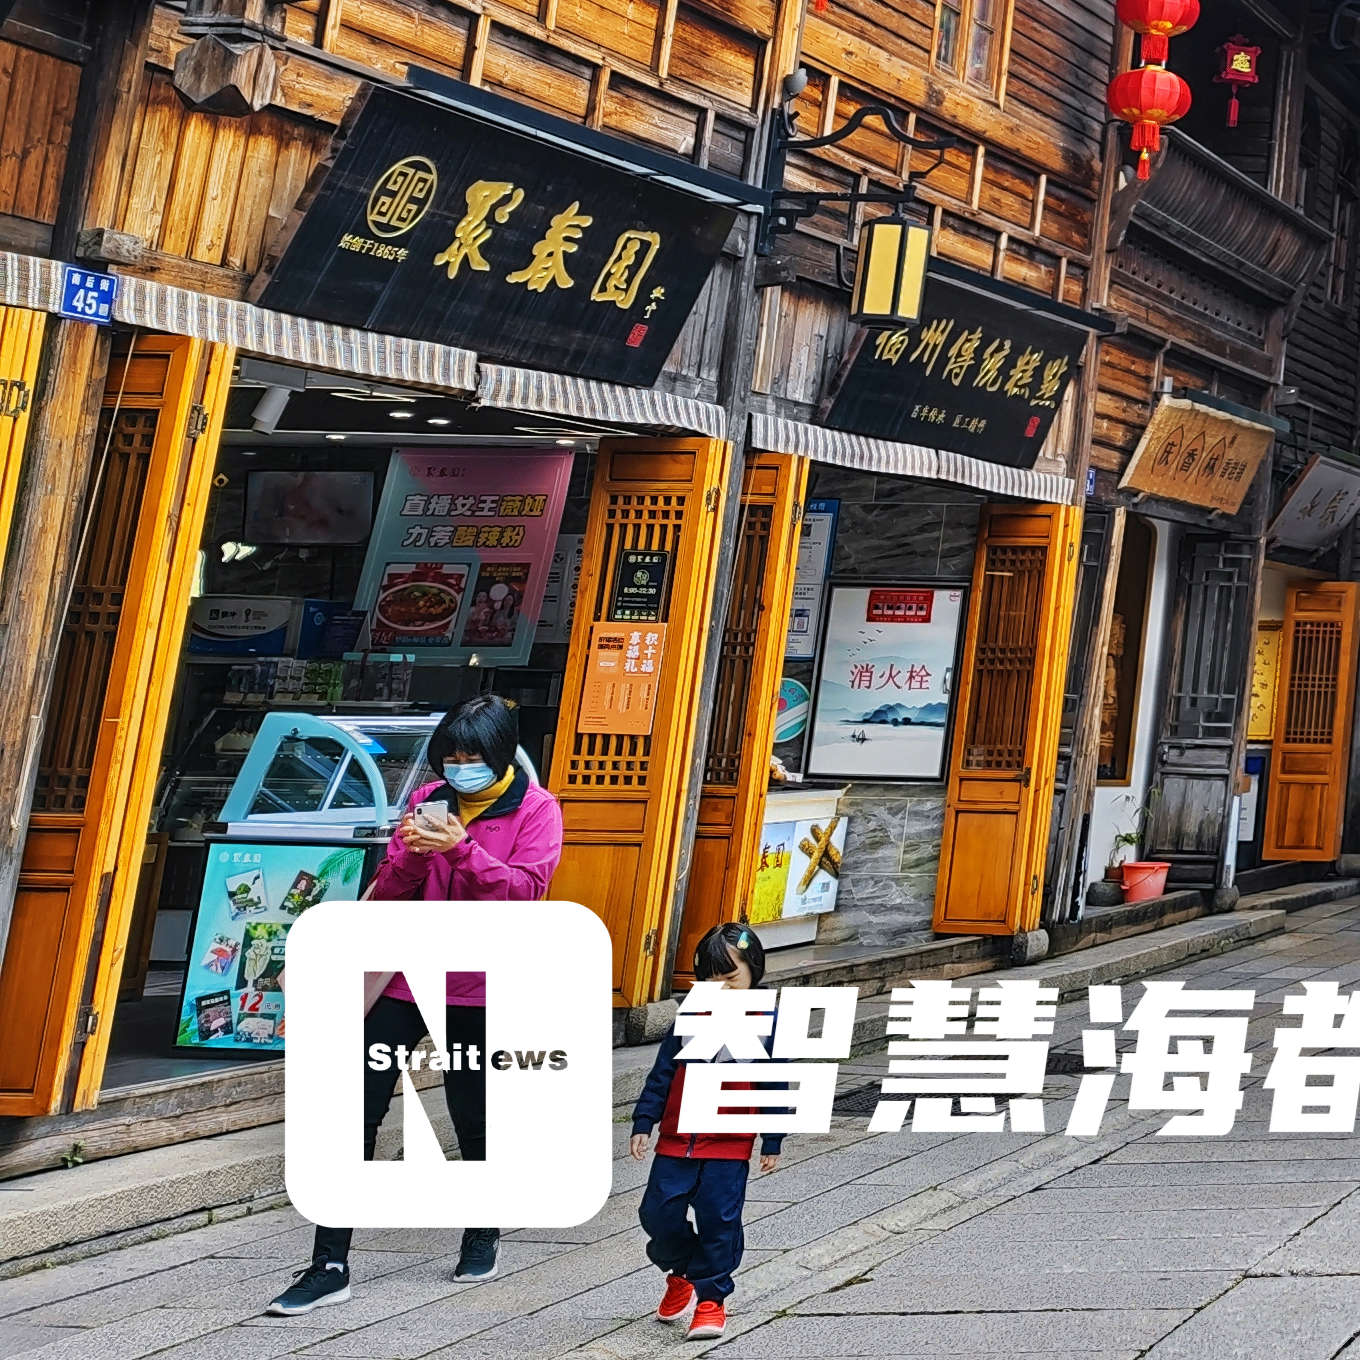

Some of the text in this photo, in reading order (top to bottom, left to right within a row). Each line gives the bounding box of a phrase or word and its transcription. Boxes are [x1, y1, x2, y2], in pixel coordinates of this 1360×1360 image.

[71, 288, 99, 315] 45
[400, 494, 548, 517] 直播女王薇娅
[402, 525, 525, 548] 力荐酸辣粉
[849, 663, 932, 691] 消火栓
[239, 992, 263, 1012] 12
